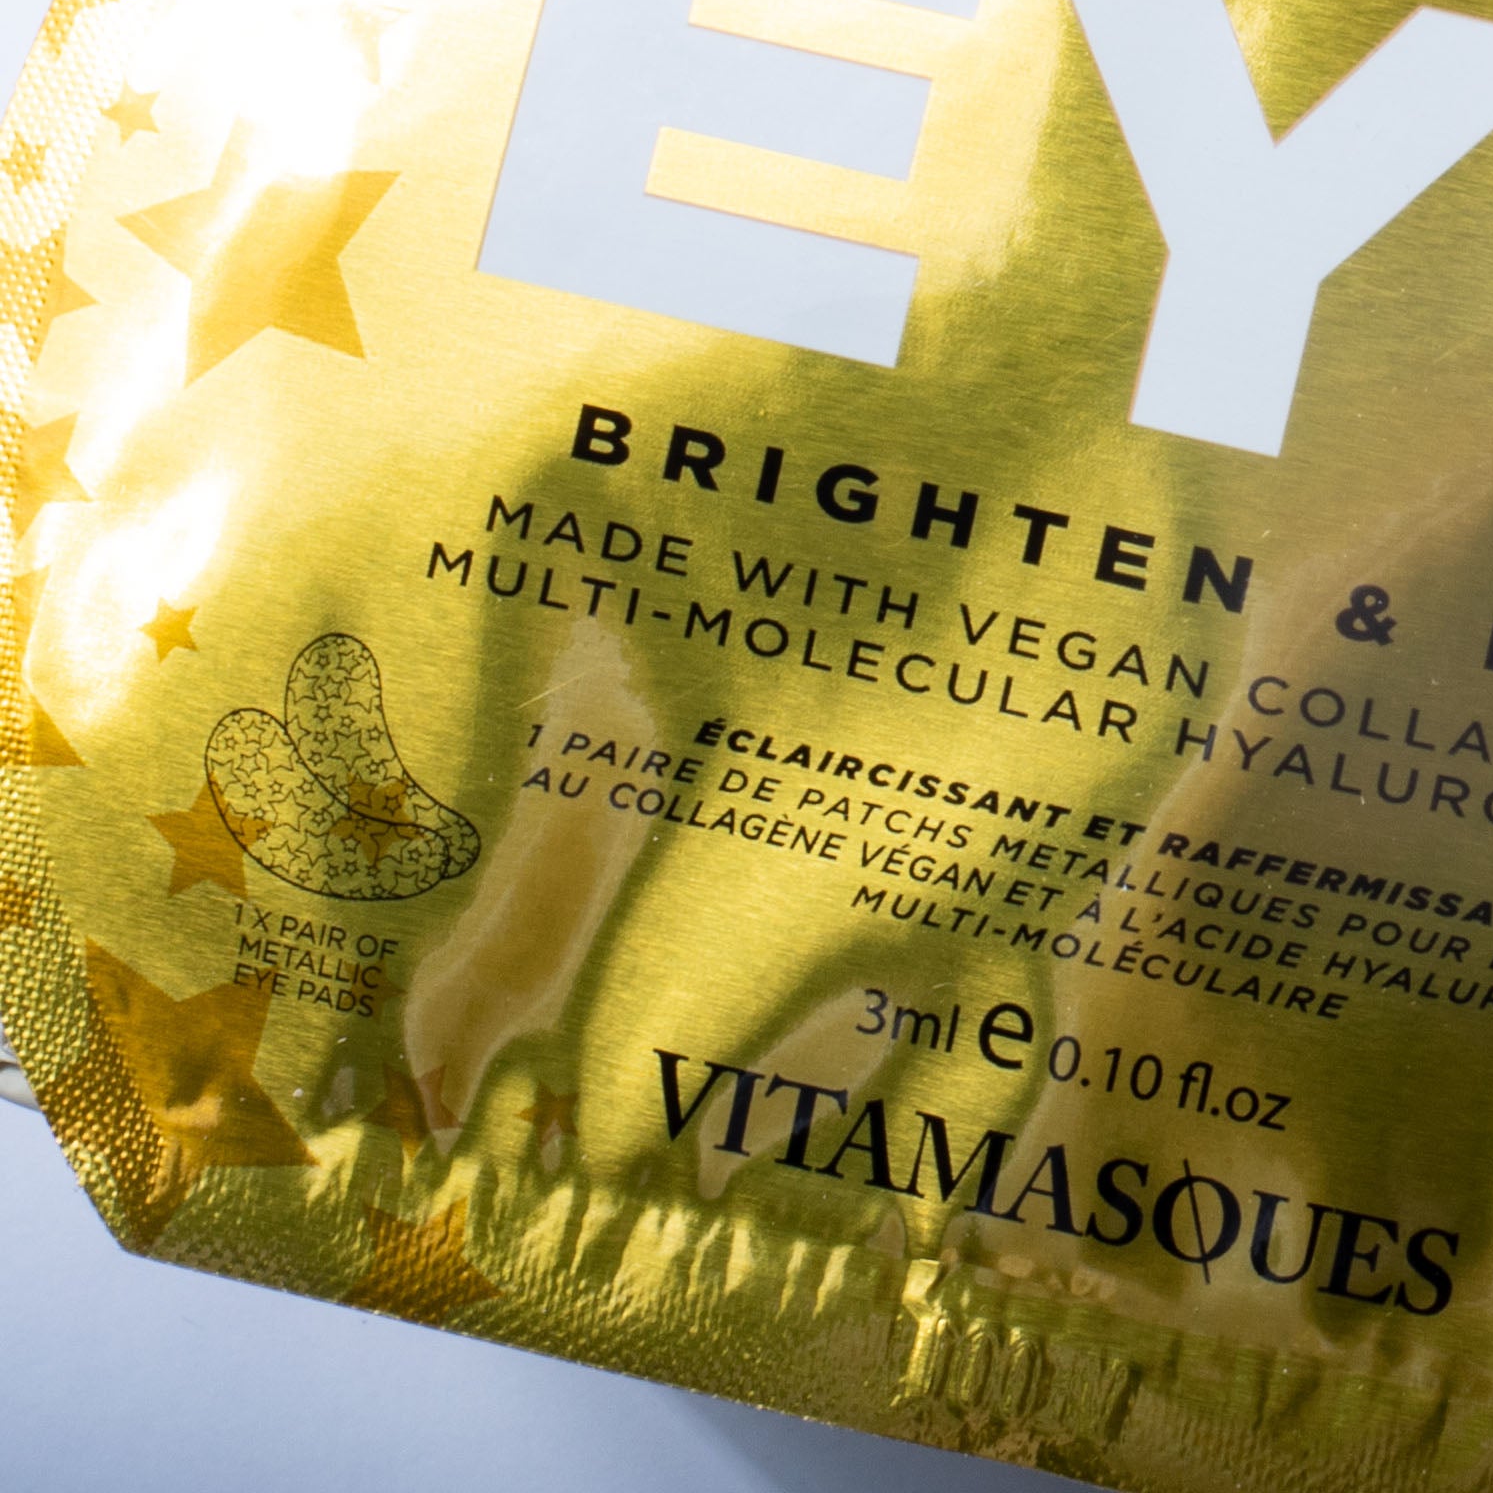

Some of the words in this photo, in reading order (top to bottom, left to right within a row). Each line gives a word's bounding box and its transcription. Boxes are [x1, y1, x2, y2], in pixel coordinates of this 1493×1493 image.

[486, 494, 694, 577] MADE
[731, 550, 920, 630] WITH
[958, 604, 1209, 699] VEGAN
[570, 404, 1254, 614] BRIGHTEN
[1336, 584, 1397, 646] &
[426, 541, 1138, 744] MULTI-MOLECULAR
[522, 766, 590, 800] AU
[609, 781, 847, 861] COLLAGÈNE
[861, 841, 994, 897] VÉGAN
[1003, 880, 1064, 912] ET
[1076, 894, 1100, 924] À
[528, 723, 542, 747] 1
[561, 732, 703, 783] PAIRE
[719, 768, 782, 803] DE
[798, 787, 973, 850] PATCHS
[990, 834, 1321, 930] METALLIQUES
[1338, 913, 1472, 963] POUR
[694, 718, 1071, 829] ÉCLAIRCISSANT
[1083, 817, 1146, 847] ET
[234, 903, 244, 924] 1
[252, 907, 272, 930] X
[280, 914, 347, 951] PAIR
[357, 935, 399, 959] OF
[234, 964, 287, 998] EYE
[298, 979, 375, 1017] PADS
[239, 935, 383, 990] METALLIC
[851, 886, 1348, 1021] MULTI-MOLÉCULAIRE
[855, 988, 962, 1054] 3ml
[1048, 1034, 1164, 1101] 0.10
[653, 1049, 1461, 1317] VITAMASQUES
